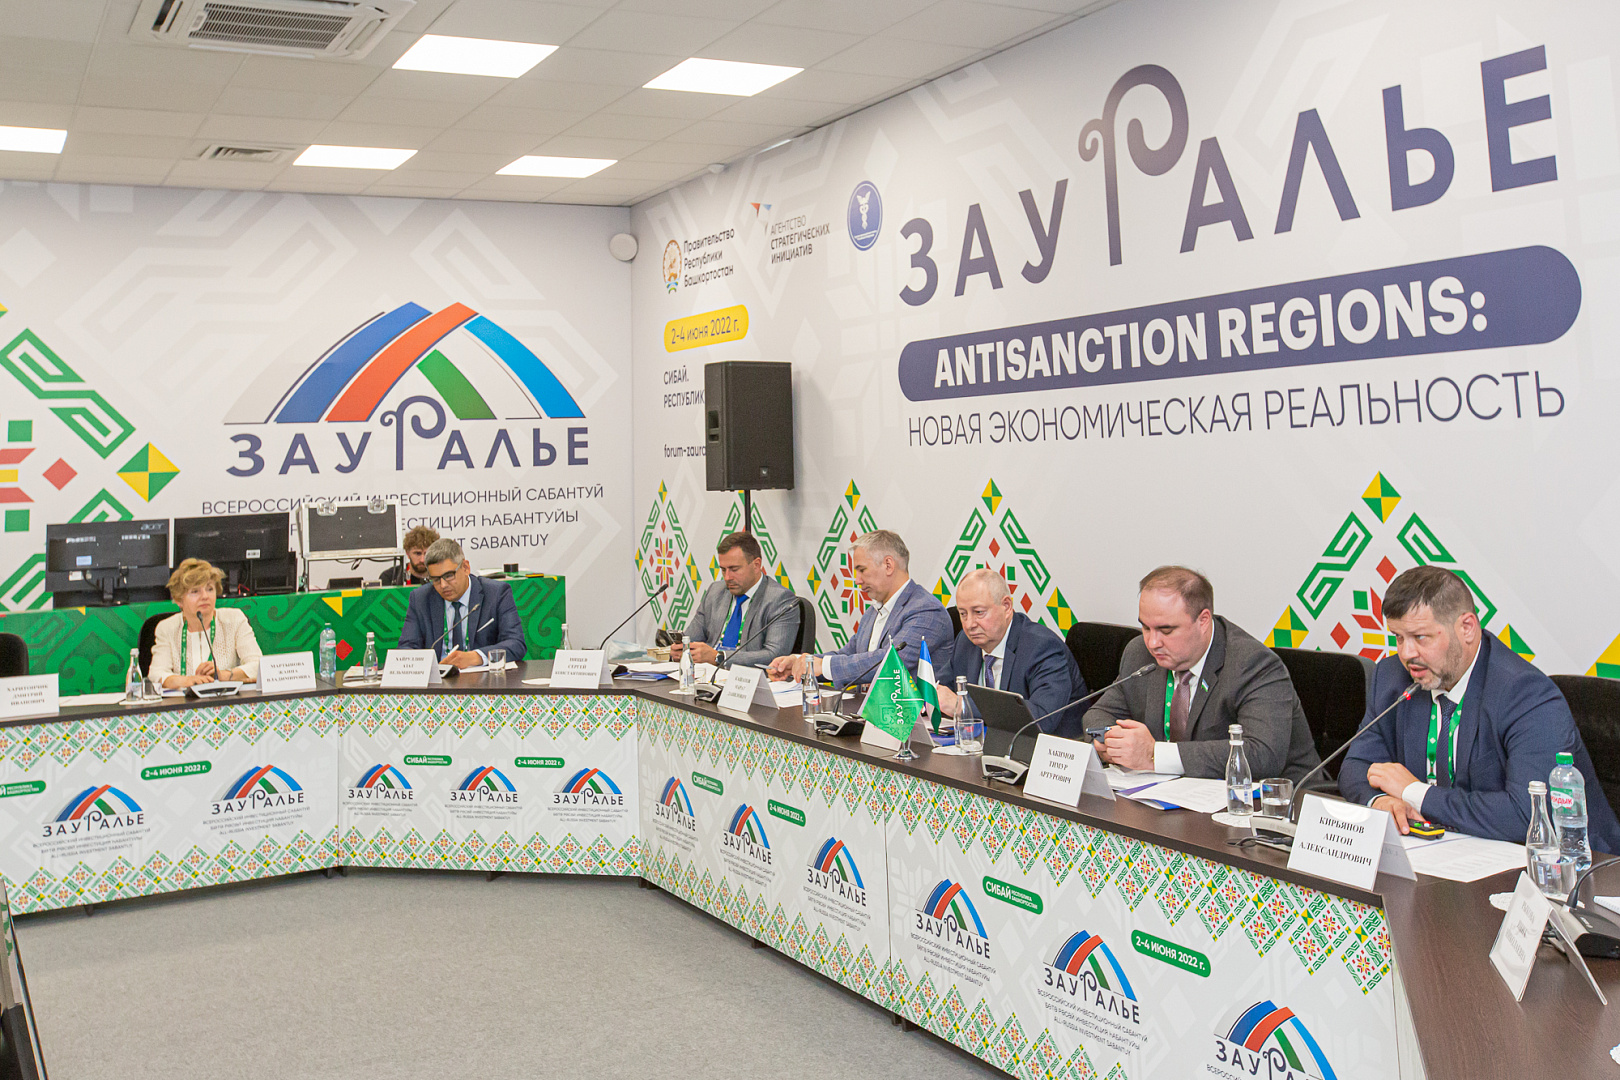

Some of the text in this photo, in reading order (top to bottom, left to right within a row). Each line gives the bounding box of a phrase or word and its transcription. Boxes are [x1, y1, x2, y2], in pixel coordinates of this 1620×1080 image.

[899, 44, 1559, 307] ЗАУРАЛЬЕ
[770, 215, 807, 236] АГЕНТСТВО
[683, 228, 735, 255] Правительство
[770, 223, 831, 250] СТРАТЕГИЧЕСКИХ
[684, 250, 723, 270] Республики
[771, 243, 813, 264] ИНИЦИАТИВ
[684, 265, 734, 287] Башкортостан
[671, 316, 740, 344] 2-4 июня 2022 г.
[934, 275, 1488, 388] ANTISANCTION REGIONS:
[664, 390, 705, 408] РЕСПУБЛИК
[908, 370, 1566, 447] НОВАЯ ЭКОНОМИЧЕСКАЯ РЕАЛЬНОСТЬ
[226, 395, 589, 477] ЗАУРАЛЬЕ
[664, 444, 706, 458] forum-zaura
[526, 483, 604, 501] САБАНТУЙ
[401, 515, 476, 531] ЕСТИЦИЯ
[470, 534, 549, 550] SABANTUY
[1048, 748, 1075, 760] ХАКИМОВ
[159, 766, 183, 776] ИЮНЯ
[184, 765, 201, 773] 2022
[1039, 771, 1072, 784] АРТУРОВИЧ
[348, 782, 414, 800] ЗАУРАЛЬЕ
[450, 785, 518, 803] ЗАУРАЛЬЕ
[553, 788, 624, 806] ЗАУРАЛЬЕ
[211, 789, 304, 815] ЗАУРАЛЬЕ
[42, 810, 144, 837] ЗАУРАЛЬЕ
[1319, 816, 1365, 834] КИРЬЯНОВ
[723, 831, 772, 865] ЗАУРАЛЬЕ
[1323, 833, 1353, 846] АНТОН
[1298, 842, 1373, 866] АЛЕКСАНДРОВИЧ
[807, 868, 867, 907] ЗАУРАЛЬЕ
[985, 881, 1012, 899] СИБАЙ
[916, 913, 991, 959] ЗАУРАЛЬЕ
[1135, 936, 1150, 950] 2-4
[1151, 940, 1177, 960] ИЮНЯ
[1178, 951, 1198, 968] 2022
[1044, 968, 1140, 1025] ЗАУРАЛЬЕ
[1215, 1040, 1308, 1080] ЗАУР
